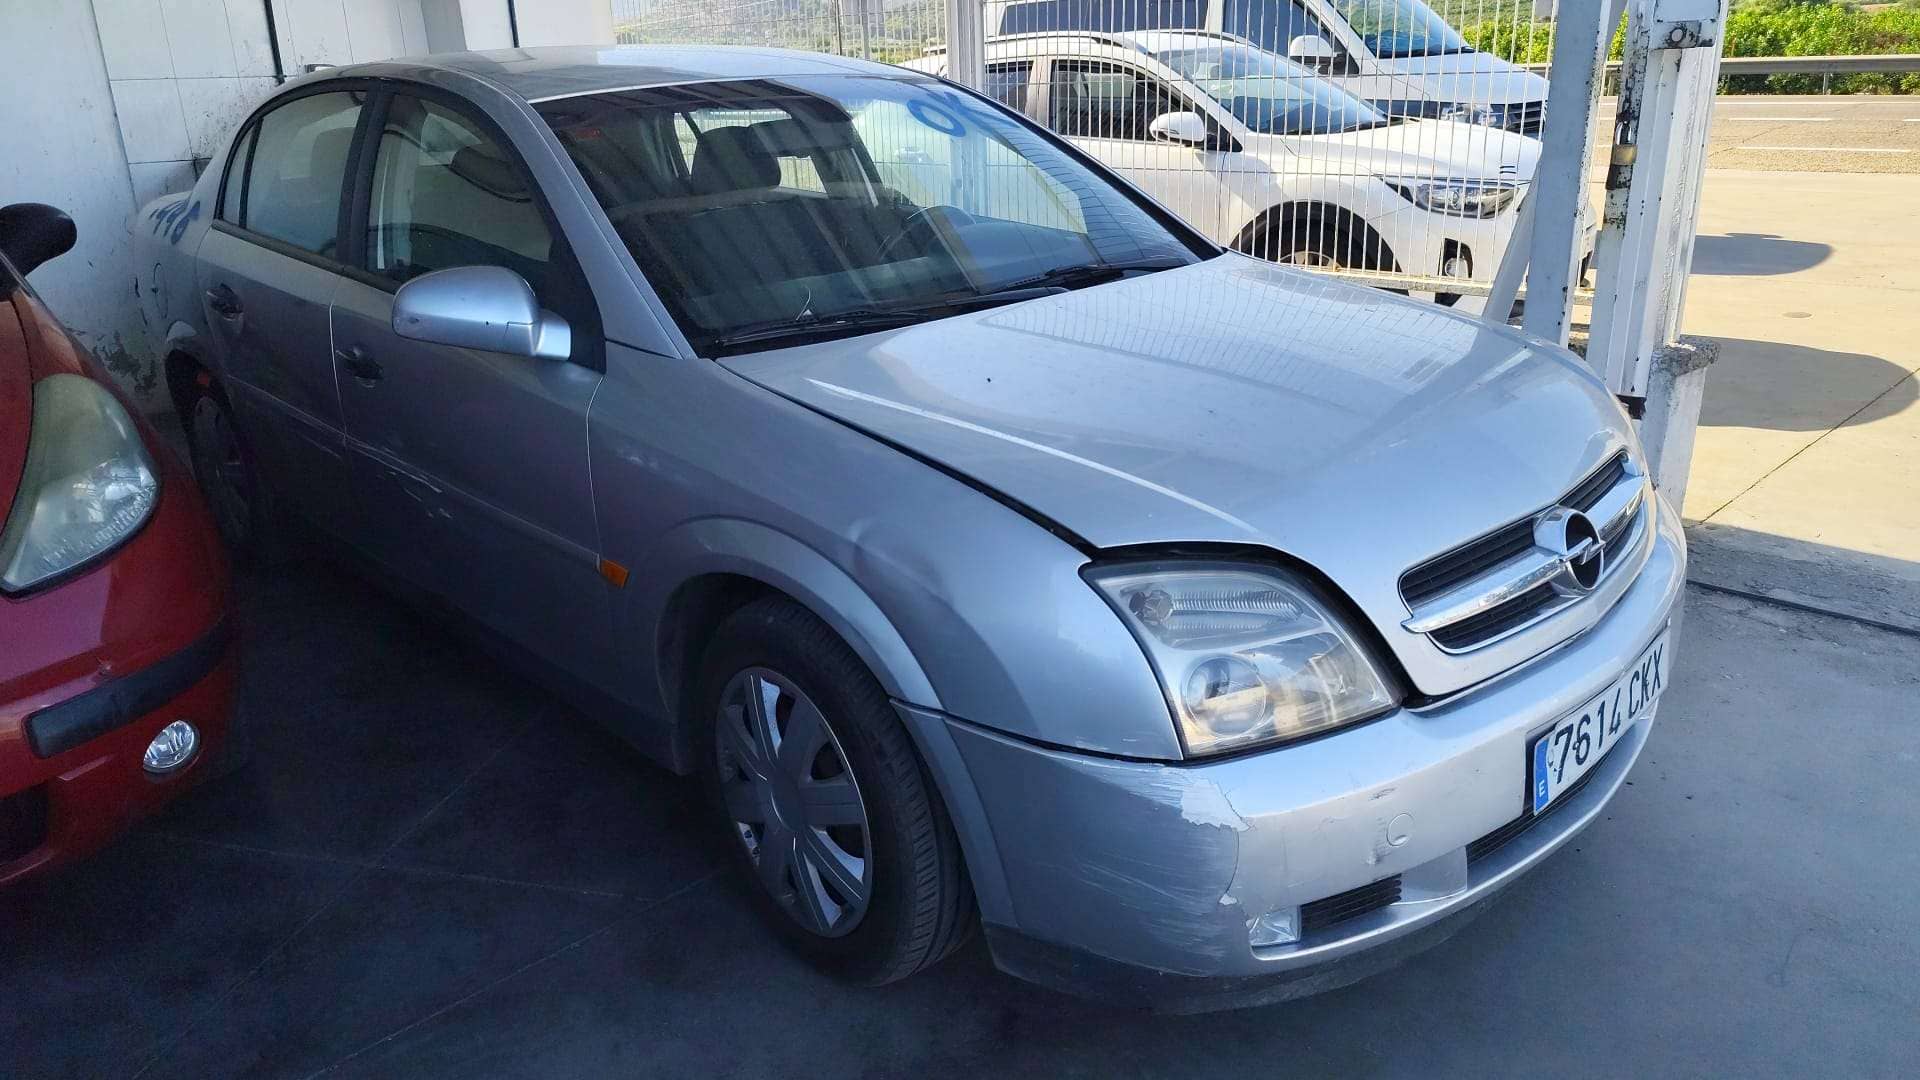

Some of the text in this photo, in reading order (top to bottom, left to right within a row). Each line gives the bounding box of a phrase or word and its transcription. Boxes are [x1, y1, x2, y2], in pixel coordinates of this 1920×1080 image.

[1538, 642, 1663, 798] E 7614 CKX
